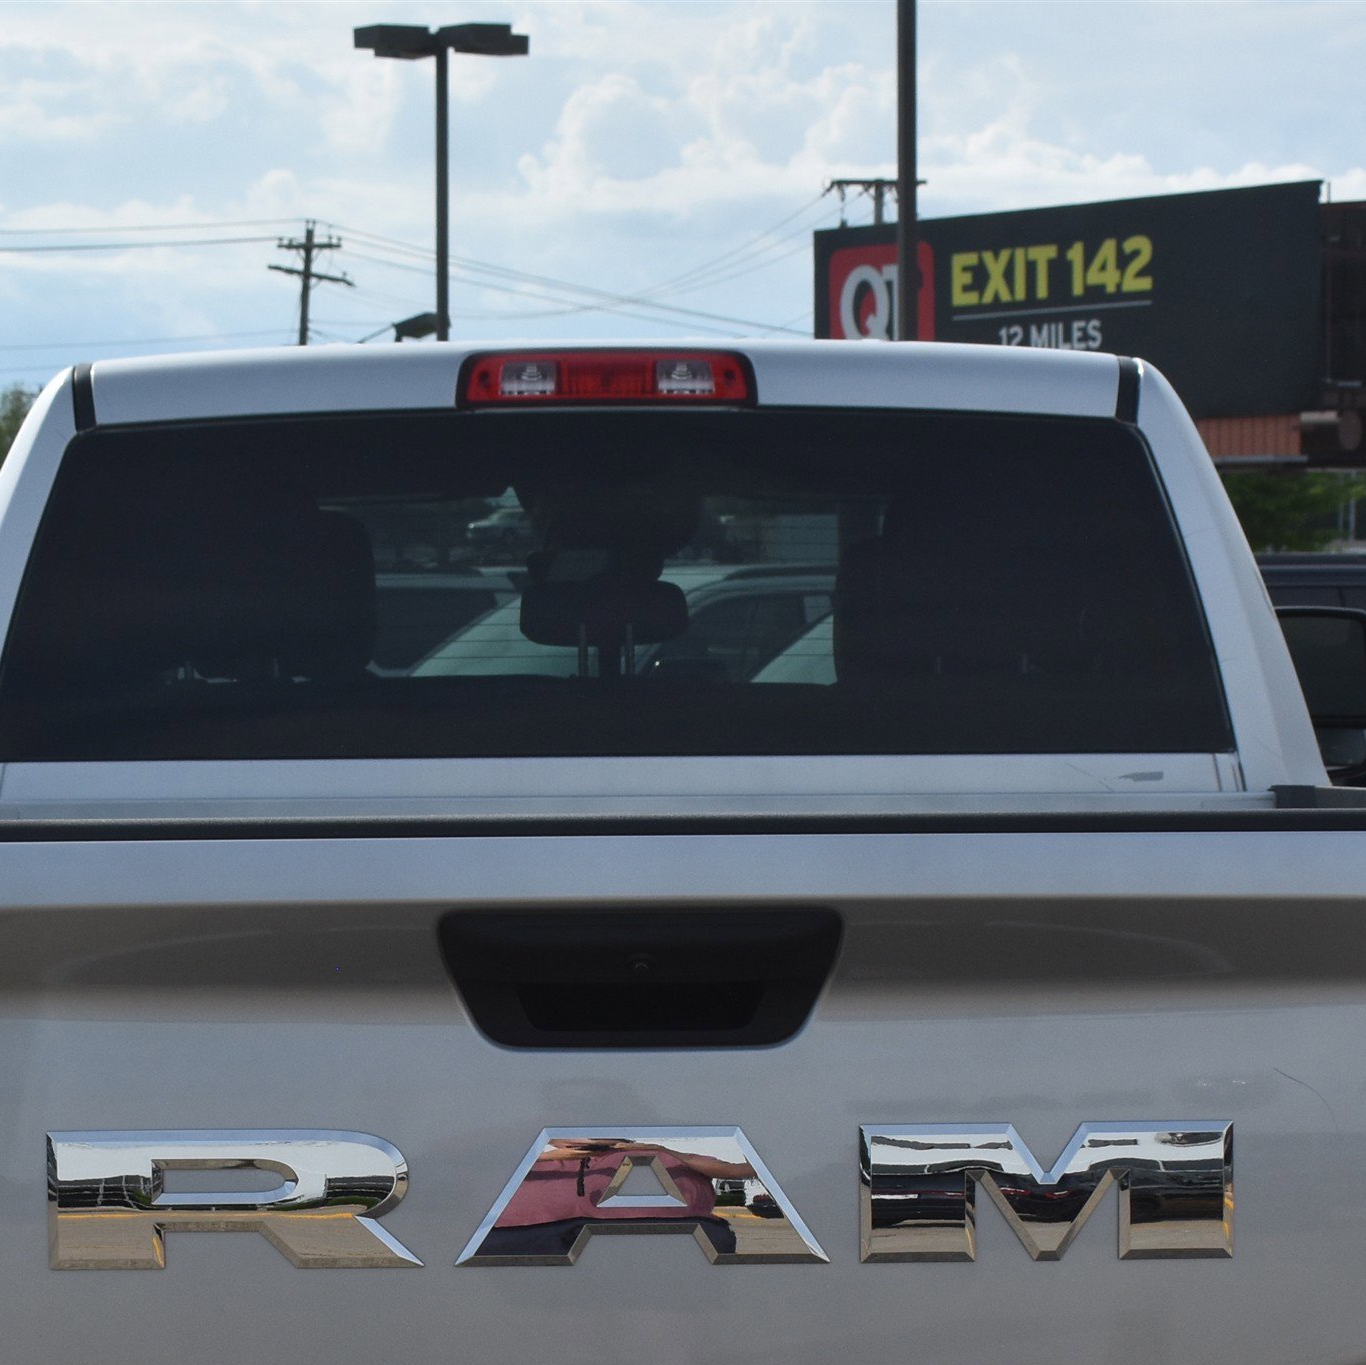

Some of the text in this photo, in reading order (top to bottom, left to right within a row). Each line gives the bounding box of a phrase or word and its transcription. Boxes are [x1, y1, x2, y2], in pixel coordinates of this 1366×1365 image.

[951, 234, 1154, 308] EXIT 142
[998, 319, 1103, 350] 12 MILES
[46, 1122, 1235, 1271] RAM
